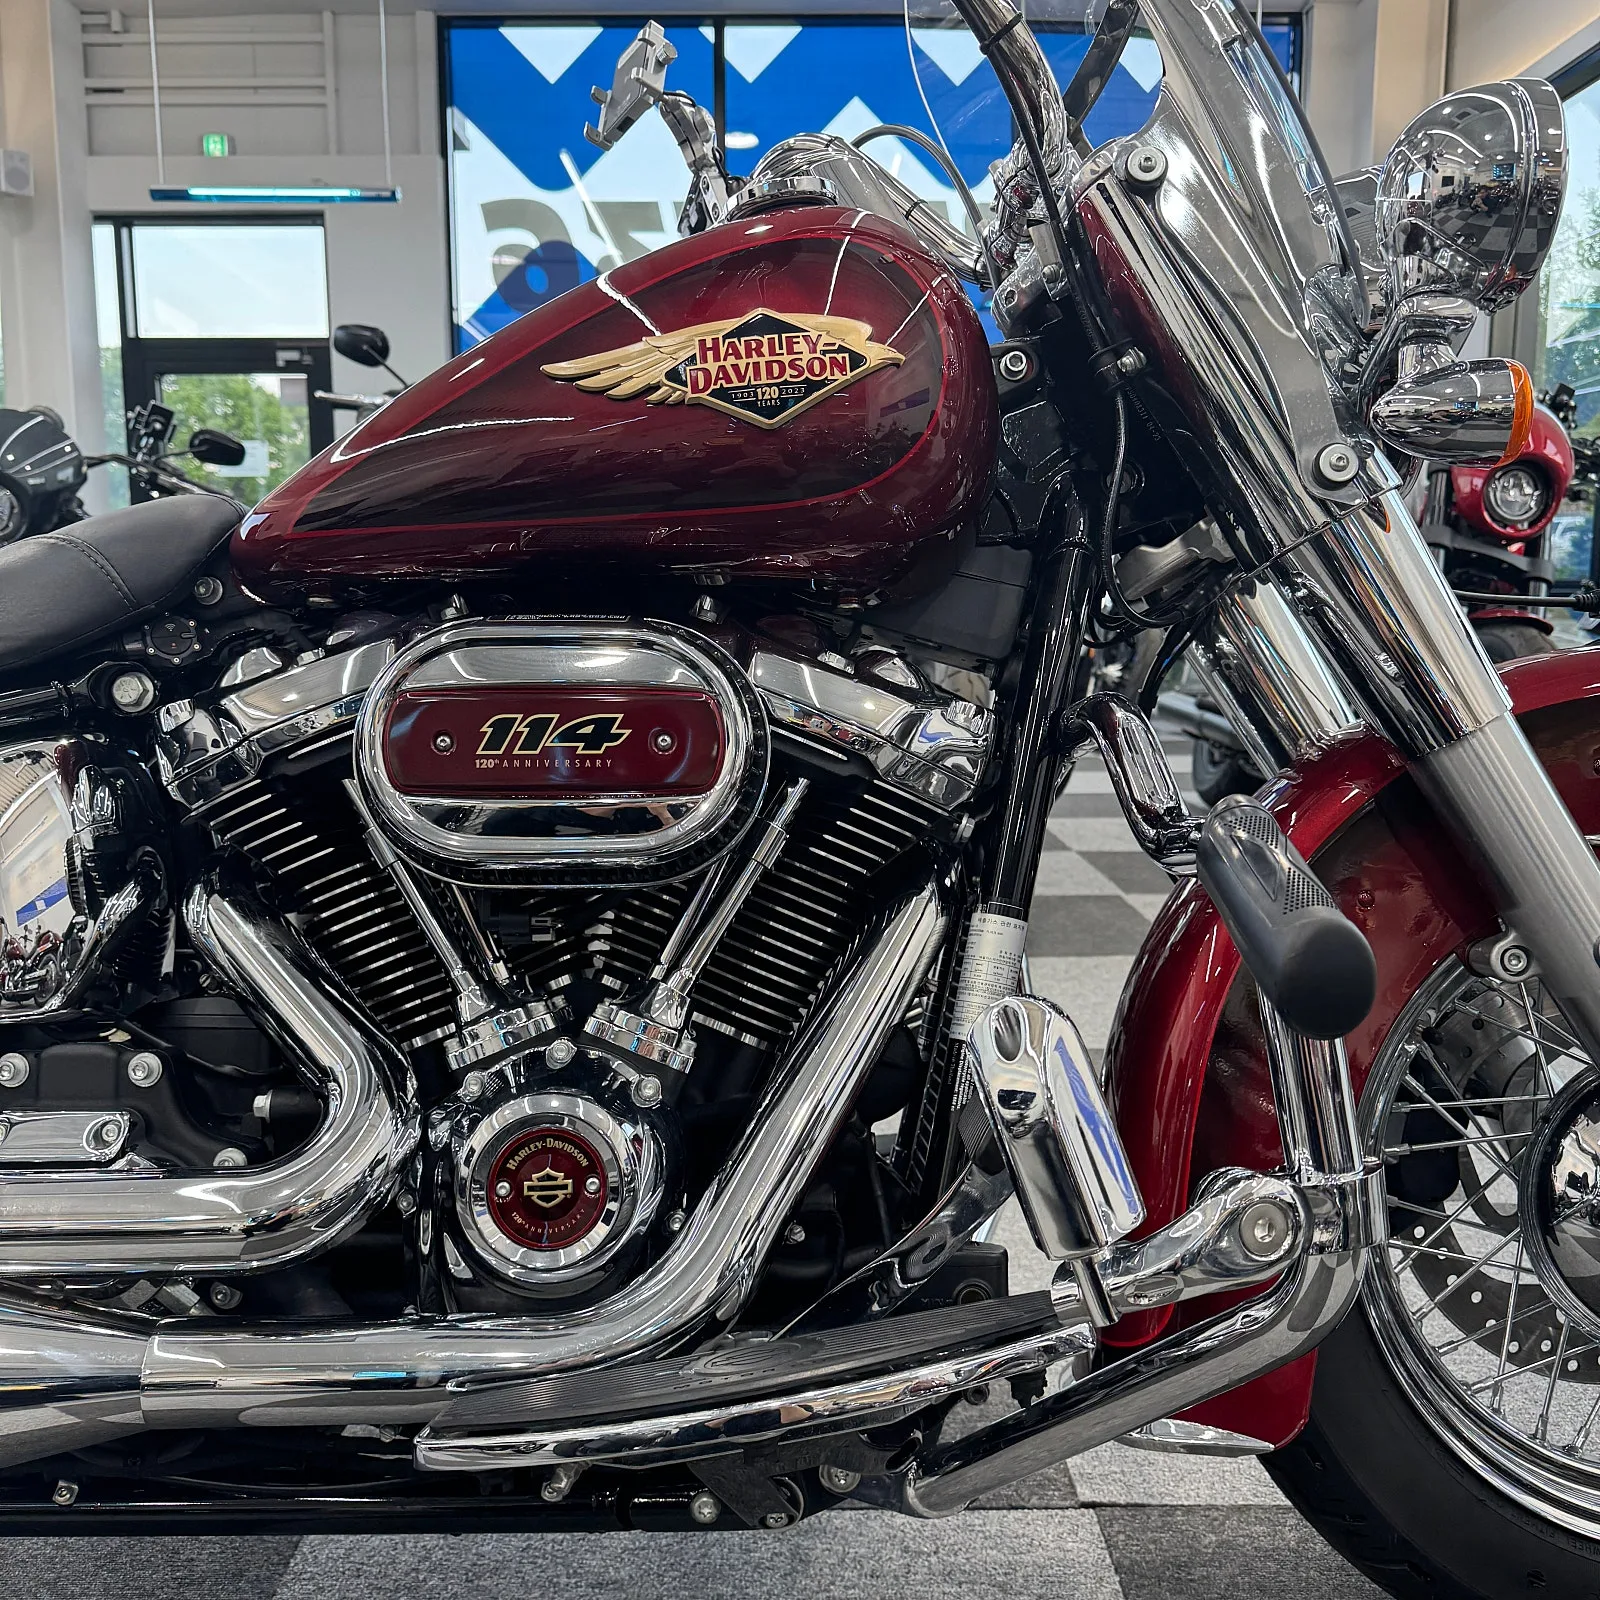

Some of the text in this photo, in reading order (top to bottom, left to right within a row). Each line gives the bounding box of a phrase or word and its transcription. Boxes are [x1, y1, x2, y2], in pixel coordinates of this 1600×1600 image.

[698, 332, 838, 365] HARLEY-
[688, 354, 849, 395] DAVIDSON
[731, 386, 805, 400] 1903 120 2023
[757, 399, 781, 408] YEARS
[476, 713, 633, 755] 114
[475, 758, 613, 769] 120th ANNIVERSARY
[506, 1137, 589, 1170] HARLEY-DAVIDSON
[524, 1208, 585, 1234] ANNVERSARY
